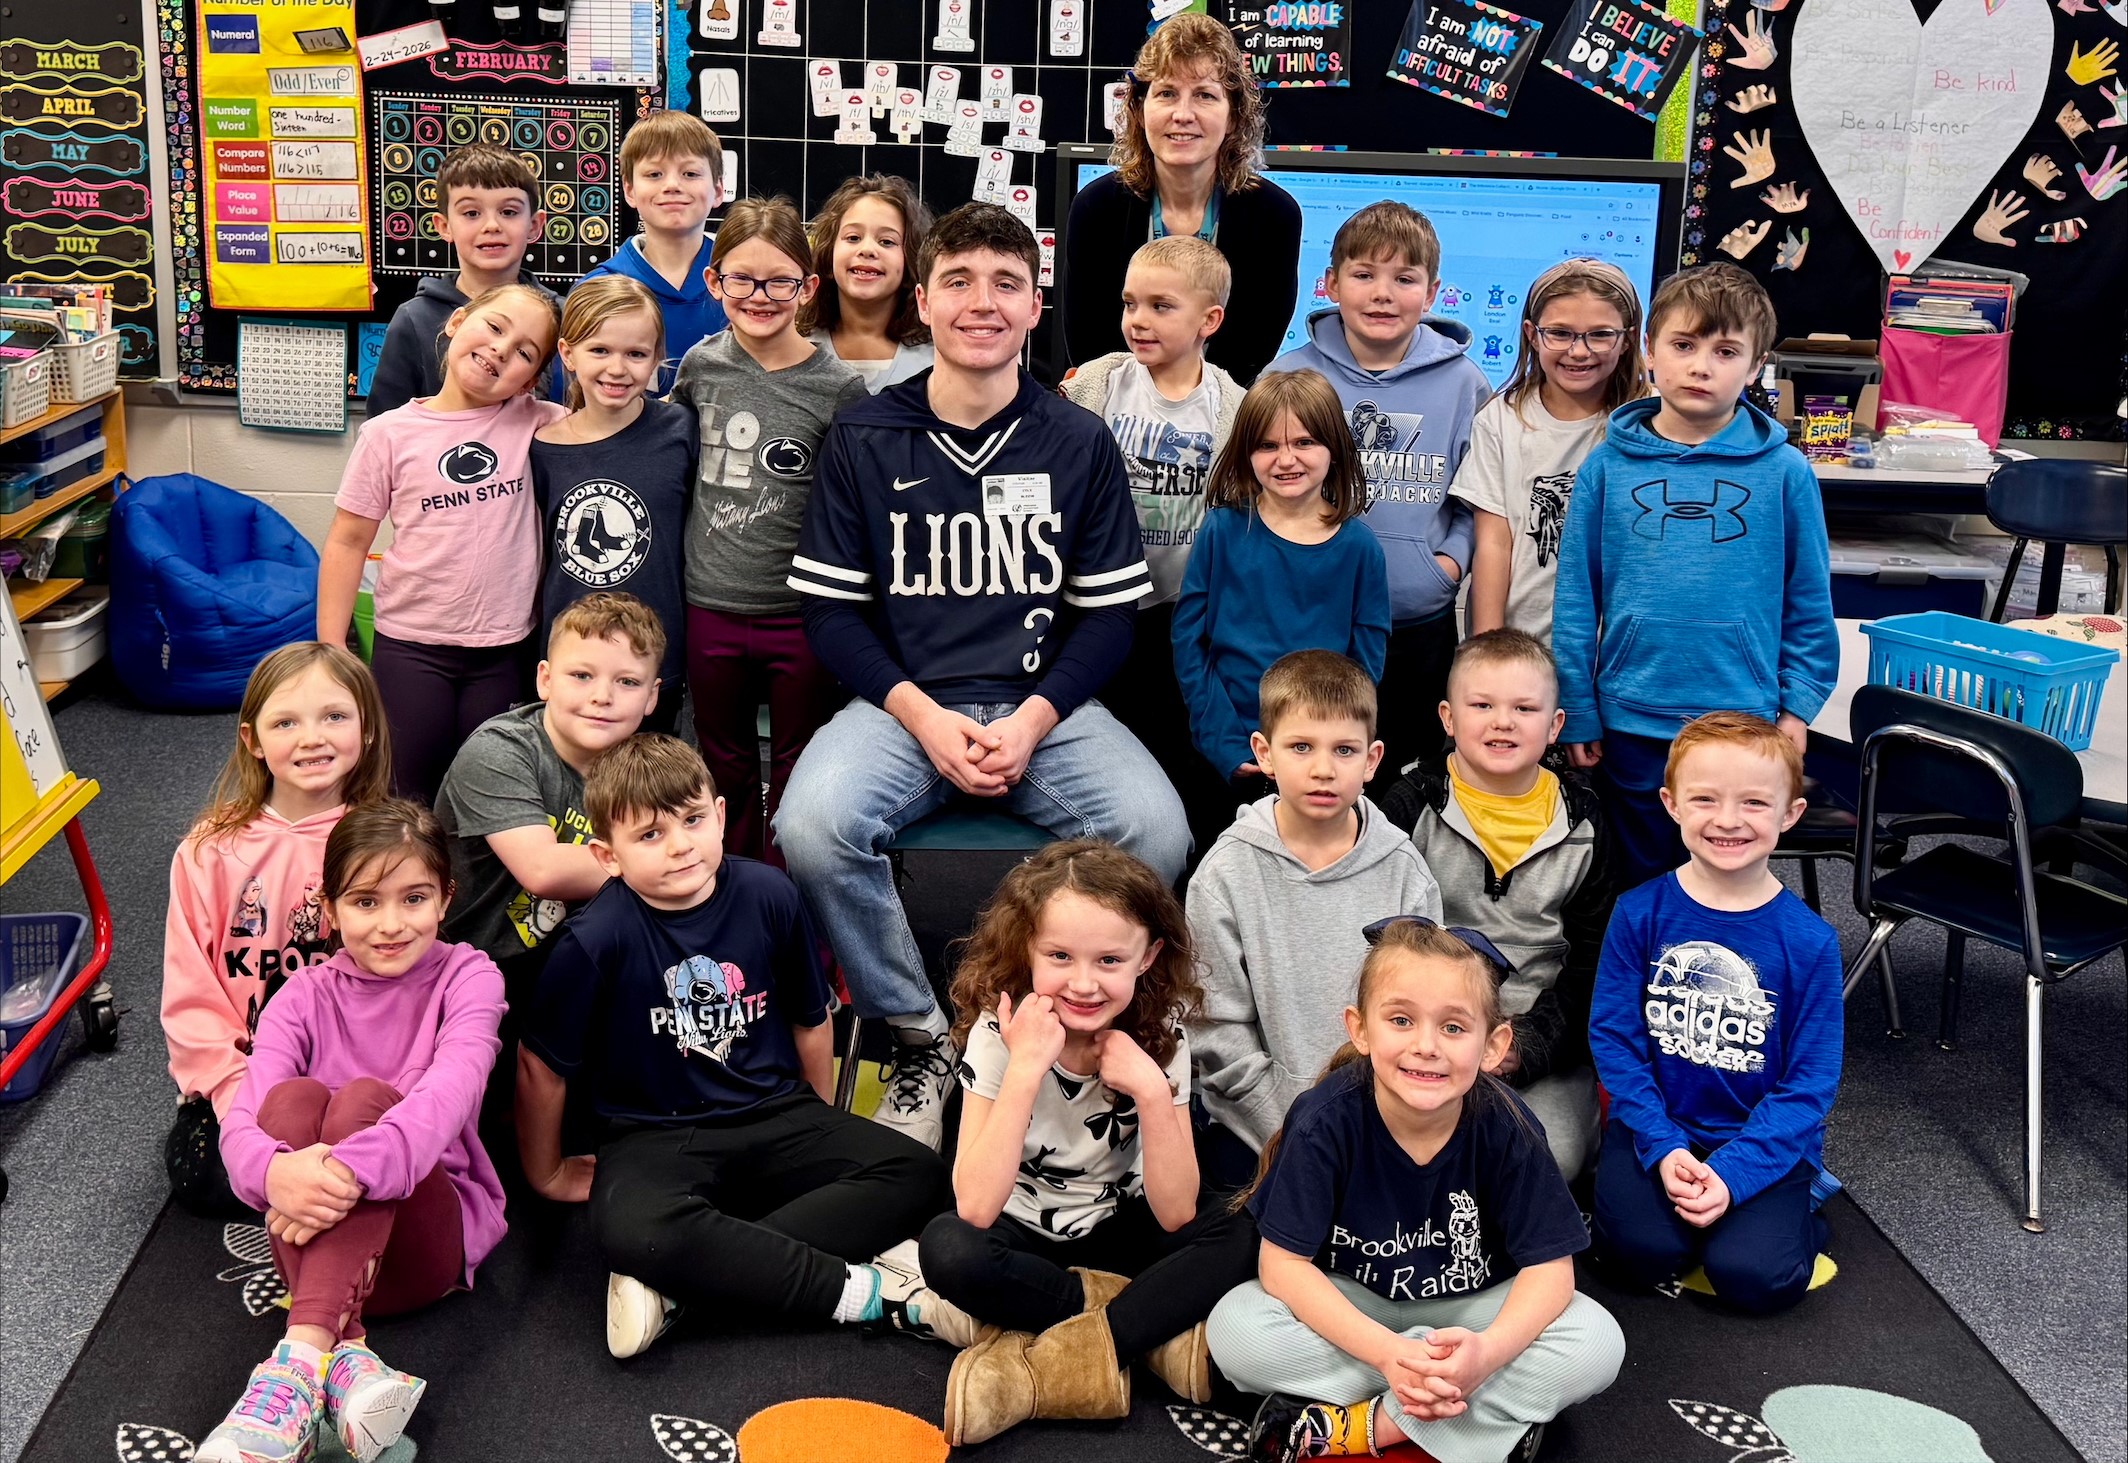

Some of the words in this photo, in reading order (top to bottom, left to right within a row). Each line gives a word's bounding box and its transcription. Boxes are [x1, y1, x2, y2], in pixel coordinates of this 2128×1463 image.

[1229, 7, 1236, 22] I
[1240, 9, 1260, 22] am
[1266, 4, 1340, 26] CAPABLE
[707, 25, 730, 33] Nasals
[1425, 6, 1439, 26] I
[1439, 13, 1467, 36] am
[1474, 20, 1516, 50] NOT
[1600, 5, 1676, 57] BELIEVE
[211, 30, 255, 40] Numeral
[1244, 33, 1262, 48] of
[1265, 33, 1324, 50] learning
[1579, 21, 1591, 37] I
[1591, 28, 1616, 50] can
[310, 38, 333, 49] 116
[365, 41, 431, 67] 2-24-2026
[1416, 32, 1473, 66] afraid
[1479, 56, 1506, 76] of
[36, 52, 100, 70] MARCH
[455, 52, 552, 70] FEBRUARY
[1276, 52, 1343, 74] THINGS.
[1397, 48, 1463, 85] DIFFICULT
[1464, 72, 1509, 101] TASKS.
[1568, 37, 1609, 73] DO
[1614, 50, 1662, 100] IT.
[274, 72, 340, 93] Odd/Even
[1934, 69, 1965, 90] Be
[1977, 68, 2016, 92] kind
[42, 98, 95, 115] APRIL
[209, 106, 251, 116] Number
[387, 102, 409, 111] Sunday
[420, 103, 442, 113] Monday
[451, 104, 475, 115] Tuesday
[480, 105, 511, 116] Wednesday
[515, 107, 542, 117] Thursday
[271, 111, 287, 119] one
[551, 108, 571, 119] Friday
[580, 111, 608, 120] Saturday
[217, 121, 245, 131] Word
[392, 121, 400, 133] 1
[1841, 110, 1866, 130] Be
[1876, 119, 1885, 131] a
[1893, 112, 1970, 135] Listener
[425, 125, 433, 138] 2
[456, 123, 467, 136] 3
[491, 127, 499, 140] 4
[524, 127, 532, 140] 5
[557, 130, 566, 141] 6
[590, 131, 597, 143] 7
[51, 143, 90, 160] MAY
[217, 148, 265, 159] Compare
[394, 152, 403, 164] 8
[219, 163, 266, 173] Numbers
[427, 156, 435, 168] 9
[584, 162, 599, 175] 14
[51, 190, 100, 208] JUNE
[228, 191, 256, 200] Place
[391, 190, 405, 203] 15
[423, 187, 437, 200] 16
[553, 191, 568, 205] 20
[588, 194, 602, 207] 21
[1858, 197, 1881, 216] Be
[228, 206, 258, 215] Value
[393, 220, 407, 232] 22
[553, 224, 567, 237] 27
[587, 225, 602, 238] 28
[1870, 219, 1942, 240] Confident
[217, 231, 268, 243] Expanded
[55, 236, 100, 253] JULY
[230, 246, 256, 256] Form
[1360, 451, 1446, 483] KVILLE
[421, 490, 470, 512] PENN
[476, 477, 525, 501] STATE
[1366, 483, 1441, 504] RJACKS
[557, 483, 645, 530] BROOKVILLE
[1140, 529, 1171, 545] SHED
[889, 511, 1063, 597] LIONS
[562, 559, 608, 584] BLUE
[609, 551, 643, 583] SOX
[699, 991, 767, 1031] STATE
[1645, 993, 1766, 1046] adidas
[1331, 1218, 1446, 1257] Brookville
